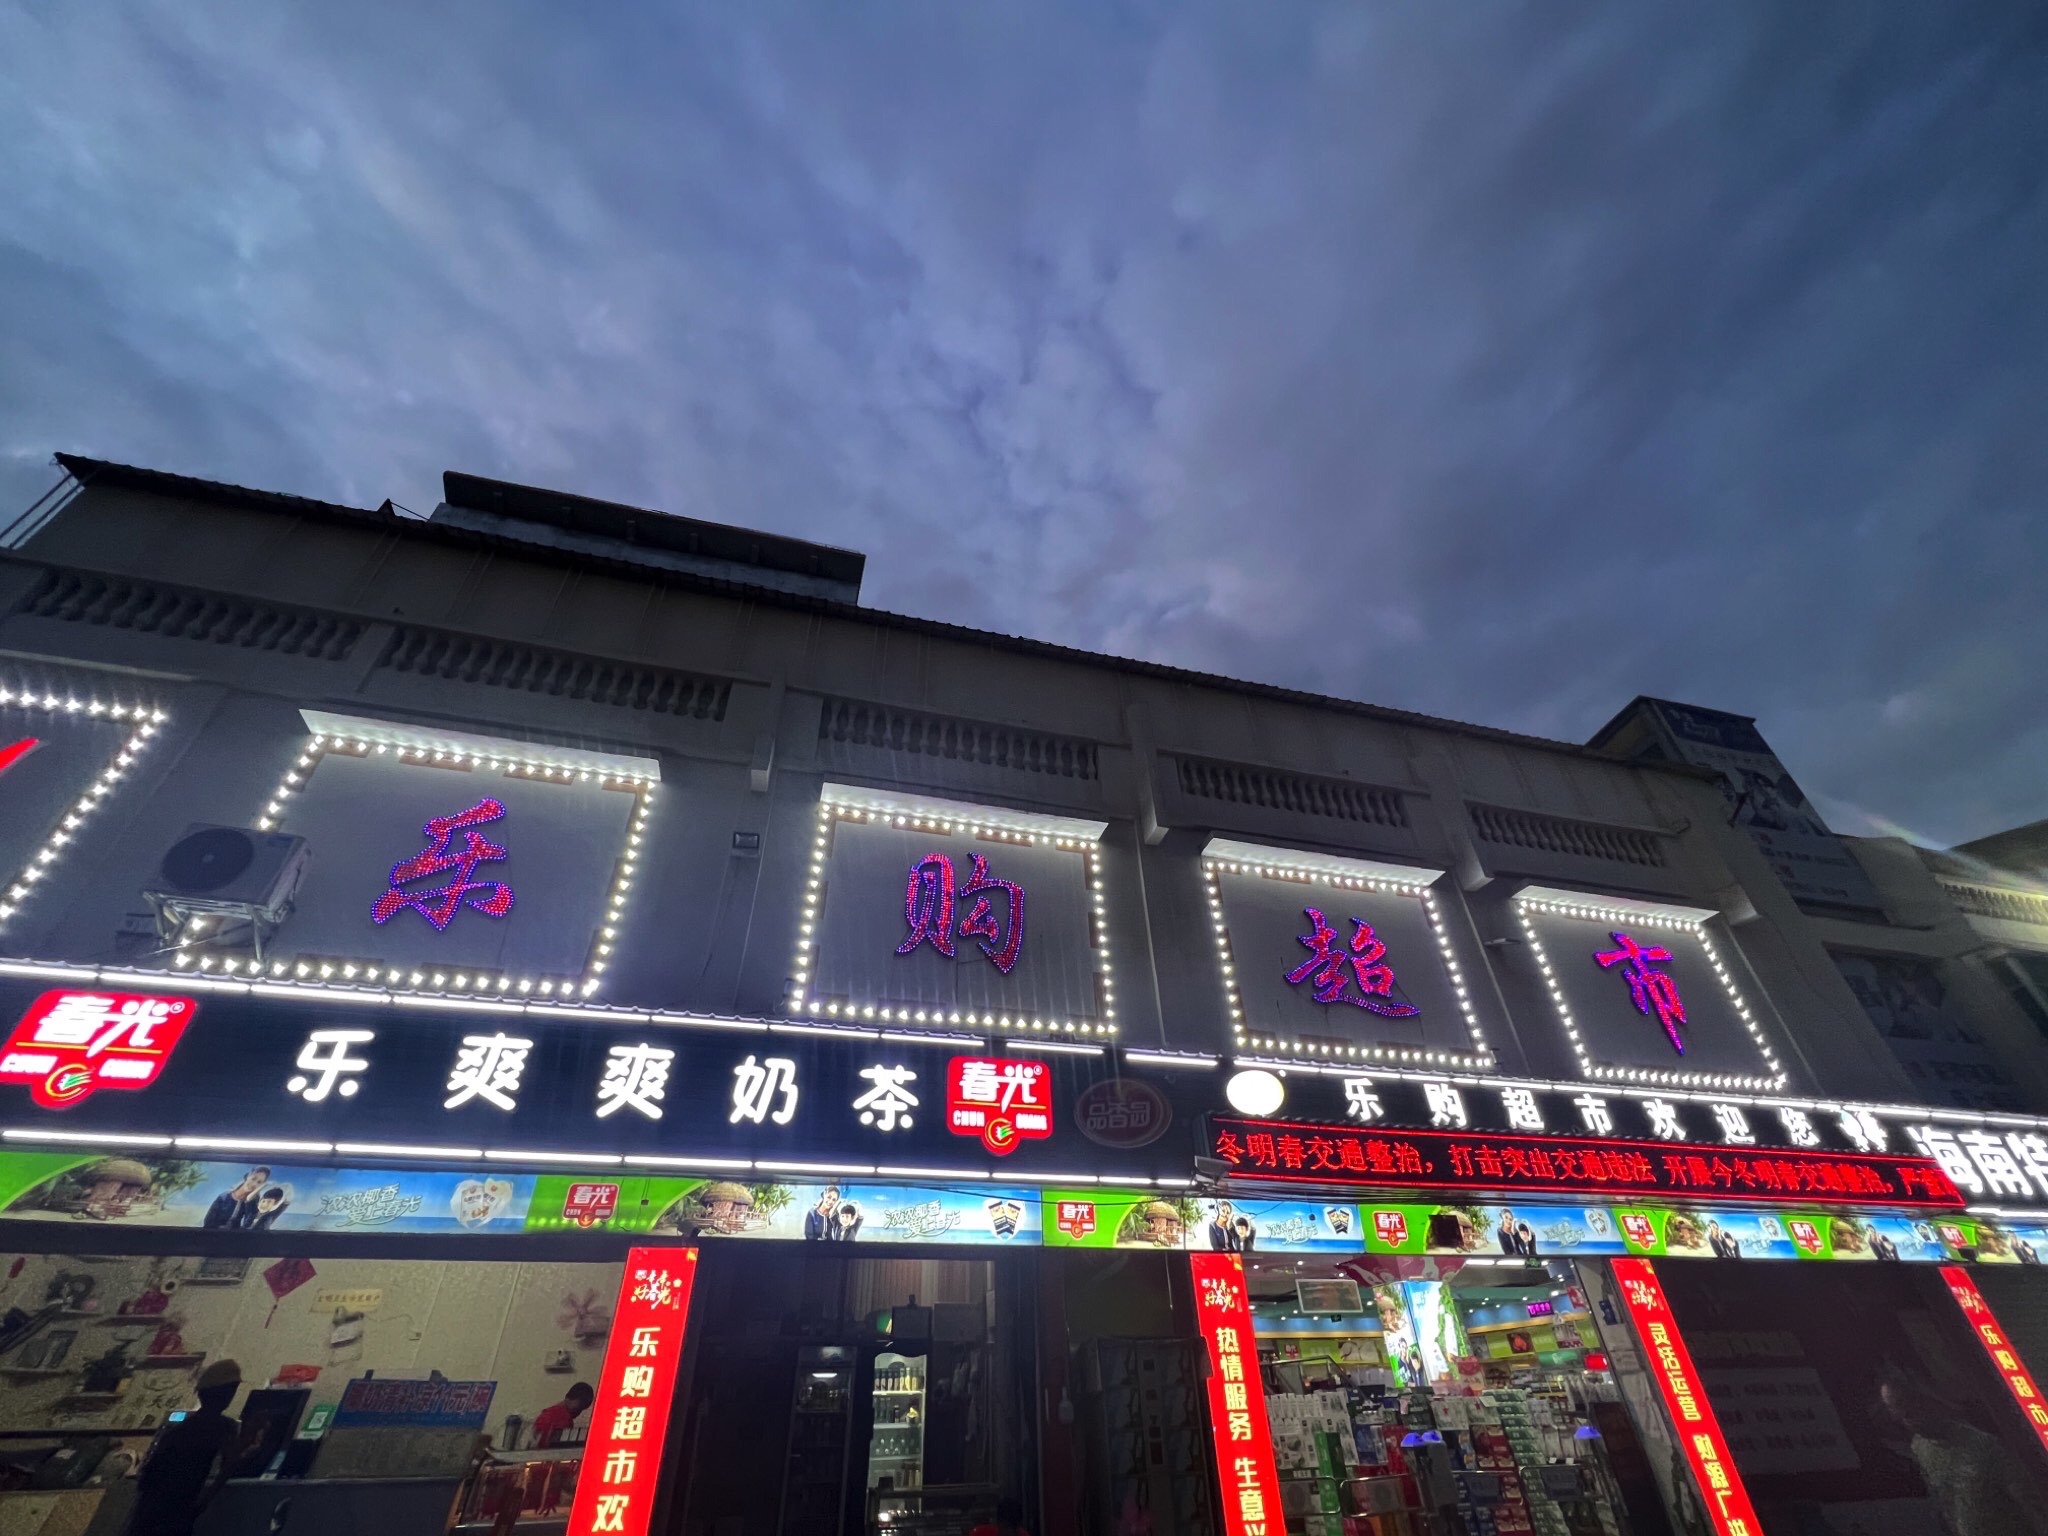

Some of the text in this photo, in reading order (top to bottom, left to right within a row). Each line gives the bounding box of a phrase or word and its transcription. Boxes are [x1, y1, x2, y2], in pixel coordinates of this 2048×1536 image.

[34, 996, 168, 1058] 春光
[287, 1030, 920, 1131] 乐爽爽奶茶
[959, 1062, 1037, 1113] 春光
[1343, 1077, 1820, 1147] 乐购超市欢迎您
[591, 1326, 662, 1533] 乐购超市欢
[1216, 1327, 1252, 1441] 热情服务
[1979, 1323, 2048, 1440] 乐购超市
